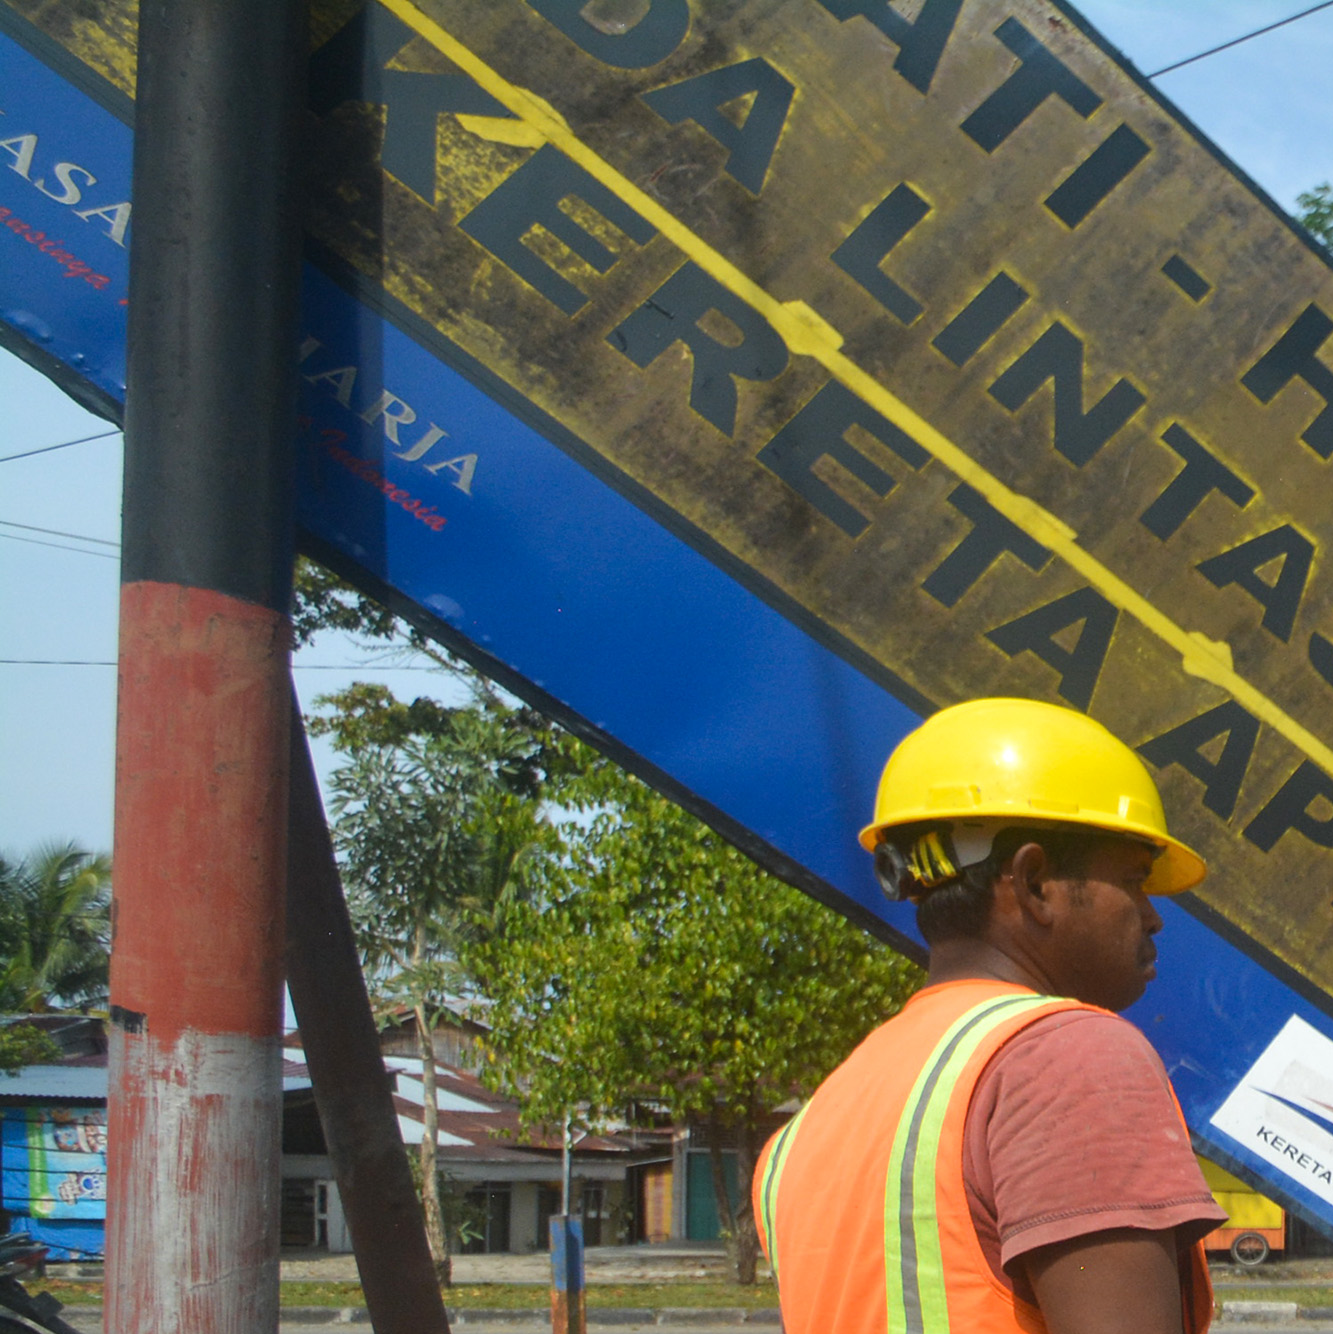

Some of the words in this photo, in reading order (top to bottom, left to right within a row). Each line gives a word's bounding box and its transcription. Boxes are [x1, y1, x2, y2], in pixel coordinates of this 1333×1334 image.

[0, 110, 133, 250] ASA
[308, 0, 1123, 714] KERETA
[1255, 1125, 1333, 1185] KERETA
